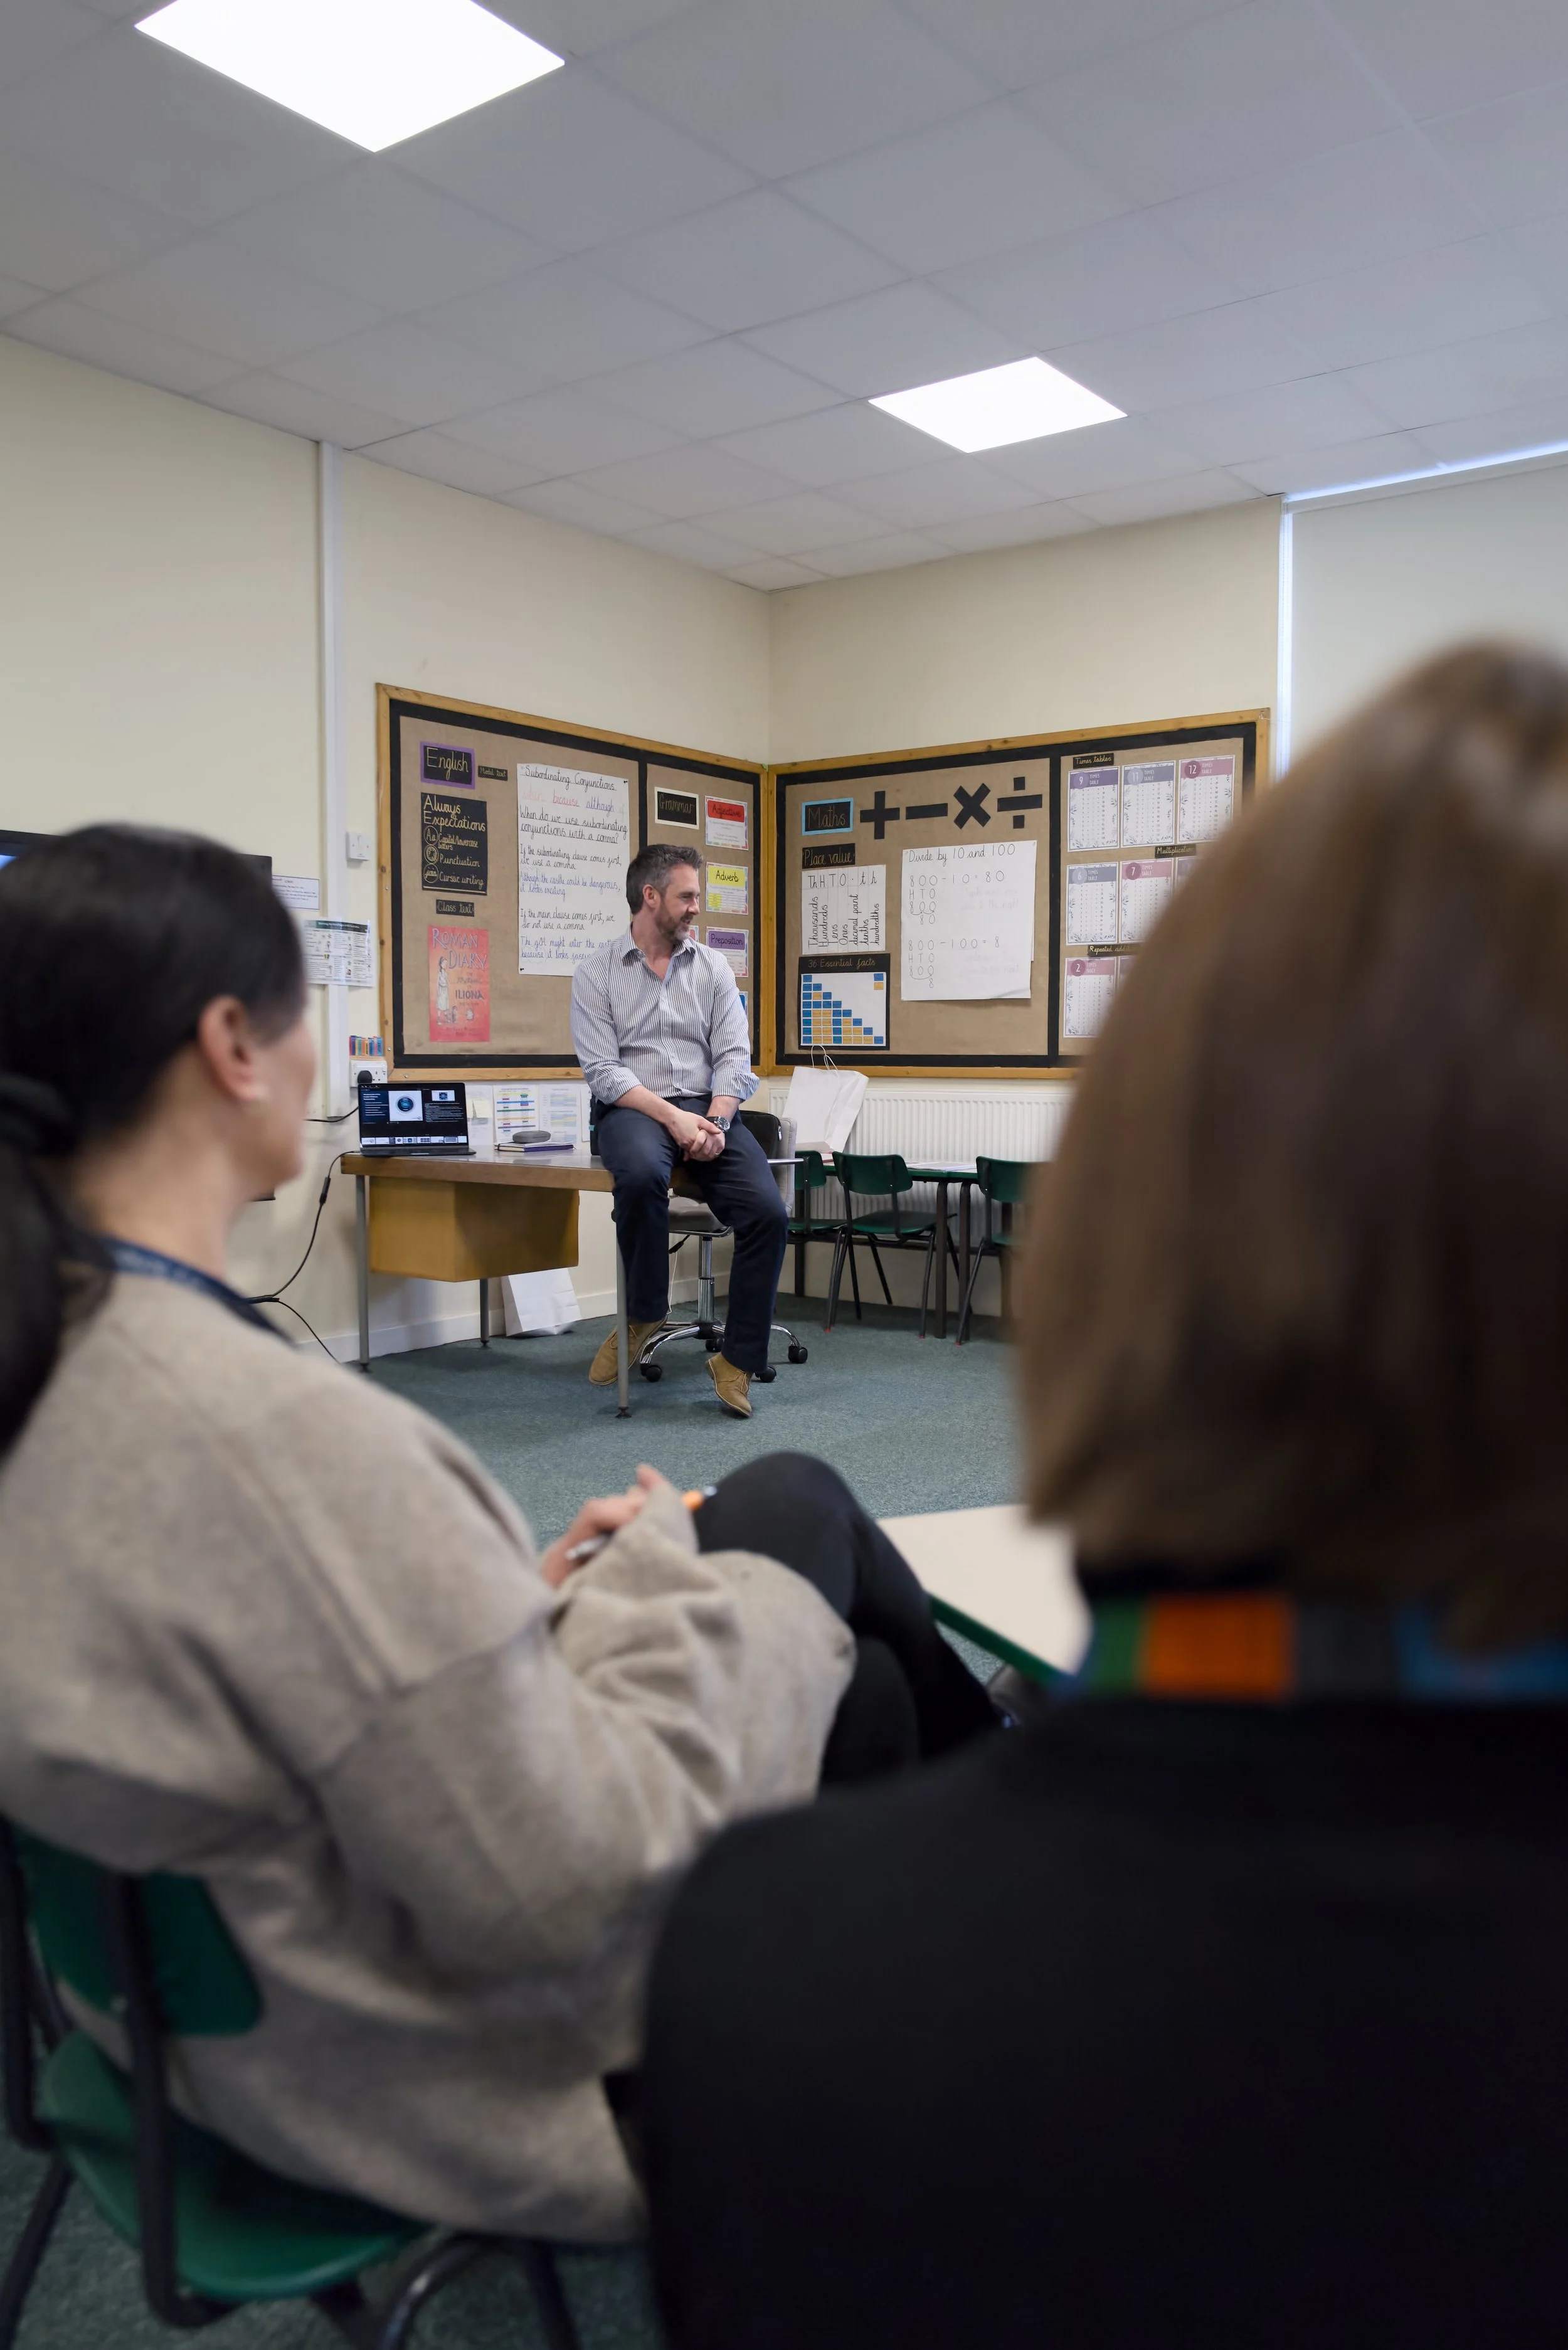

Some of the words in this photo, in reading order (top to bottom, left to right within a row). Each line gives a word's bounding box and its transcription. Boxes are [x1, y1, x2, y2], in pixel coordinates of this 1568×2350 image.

[426, 747, 469, 780] English
[1093, 754, 1112, 763] tables
[525, 765, 571, 790] Subordinating
[575, 772, 615, 793] Conjunctions
[1131, 772, 1139, 783] 11
[1189, 765, 1197, 775] 12
[1079, 776, 1083, 785] 9
[423, 794, 461, 818] Always
[553, 788, 580, 807] because
[586, 796, 615, 817] although
[659, 793, 694, 814] Grammar
[712, 803, 741, 818] Adjective
[423, 810, 486, 832] Expectations
[519, 804, 536, 820] When
[539, 807, 549, 821] do
[565, 818, 578, 826] use
[583, 817, 628, 840] subordinating
[808, 805, 845, 828] Maths
[520, 822, 566, 840] conjunctions
[569, 829, 585, 840] with
[596, 832, 618, 844] comma?
[440, 854, 480, 867] Punctuation
[537, 846, 570, 862] subordinating
[573, 849, 588, 861] clause
[590, 855, 605, 864] comes
[805, 849, 825, 865] Place
[829, 847, 853, 864] value
[909, 850, 933, 862] Divide
[937, 848, 948, 867] by
[953, 847, 965, 859] 10
[967, 845, 985, 859] and
[992, 844, 1015, 856] 100
[553, 862, 576, 870] comma
[1131, 867, 1135, 876] 7
[440, 871, 460, 883] Cursive
[462, 874, 484, 890] writing
[550, 874, 564, 884] castle
[566, 875, 580, 886] could
[582, 877, 587, 886] be
[590, 878, 620, 895] dangerous,
[716, 870, 739, 882] Adverb
[808, 876, 817, 889] Th
[820, 874, 825, 887] H
[829, 874, 836, 887] T
[520, 884, 524, 892] it
[544, 886, 566, 902] exciting
[437, 901, 456, 913] Class
[552, 906, 570, 919] clause
[849, 894, 862, 914] point
[522, 919, 529, 929] do
[808, 896, 818, 949] Thousands
[818, 904, 828, 947] Hundreds
[870, 903, 879, 946] hundredths
[432, 928, 479, 950] ROMAN
[711, 933, 743, 945] Preposition
[828, 924, 839, 944] Tens
[839, 924, 848, 945] Ones
[848, 918, 859, 946] decimal
[859, 919, 869, 945] tenths
[521, 936, 531, 946] The
[549, 936, 564, 949] might
[585, 937, 595, 948] the
[995, 936, 1000, 948] 8
[1089, 945, 1113, 955] Repeated
[448, 949, 487, 971] DIARY
[521, 947, 544, 958] because
[556, 950, 569, 960] looks
[808, 959, 817, 968] 36
[820, 958, 852, 967] Essential
[856, 958, 876, 970] facts
[1076, 963, 1080, 972] 2
[929, 977, 934, 988] 8
[455, 990, 484, 1000] ILIONA
